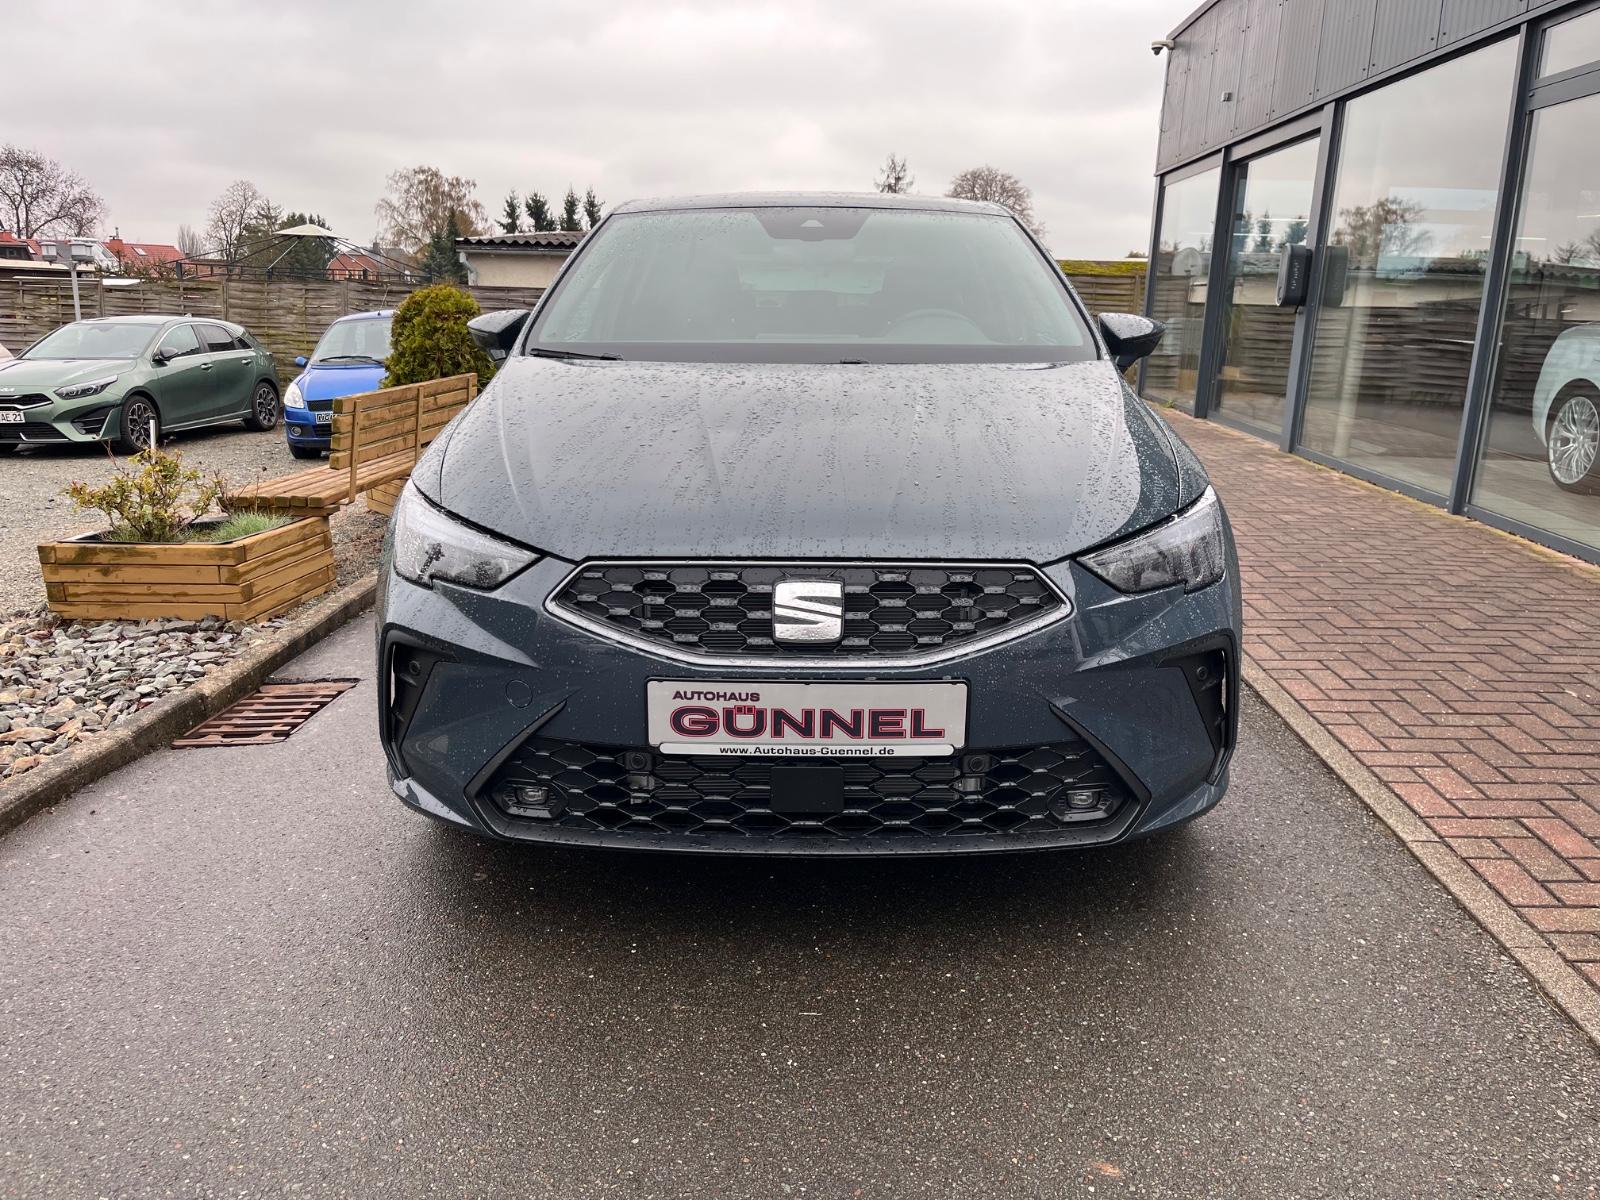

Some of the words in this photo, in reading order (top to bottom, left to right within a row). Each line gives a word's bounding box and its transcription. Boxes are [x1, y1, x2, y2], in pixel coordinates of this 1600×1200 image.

[12, 413, 24, 422] 21
[672, 690, 761, 702] AUTOHAUS
[669, 705, 946, 739] GÜNNEL
[719, 746, 895, 756] www.Autohaus-Guennel.de
